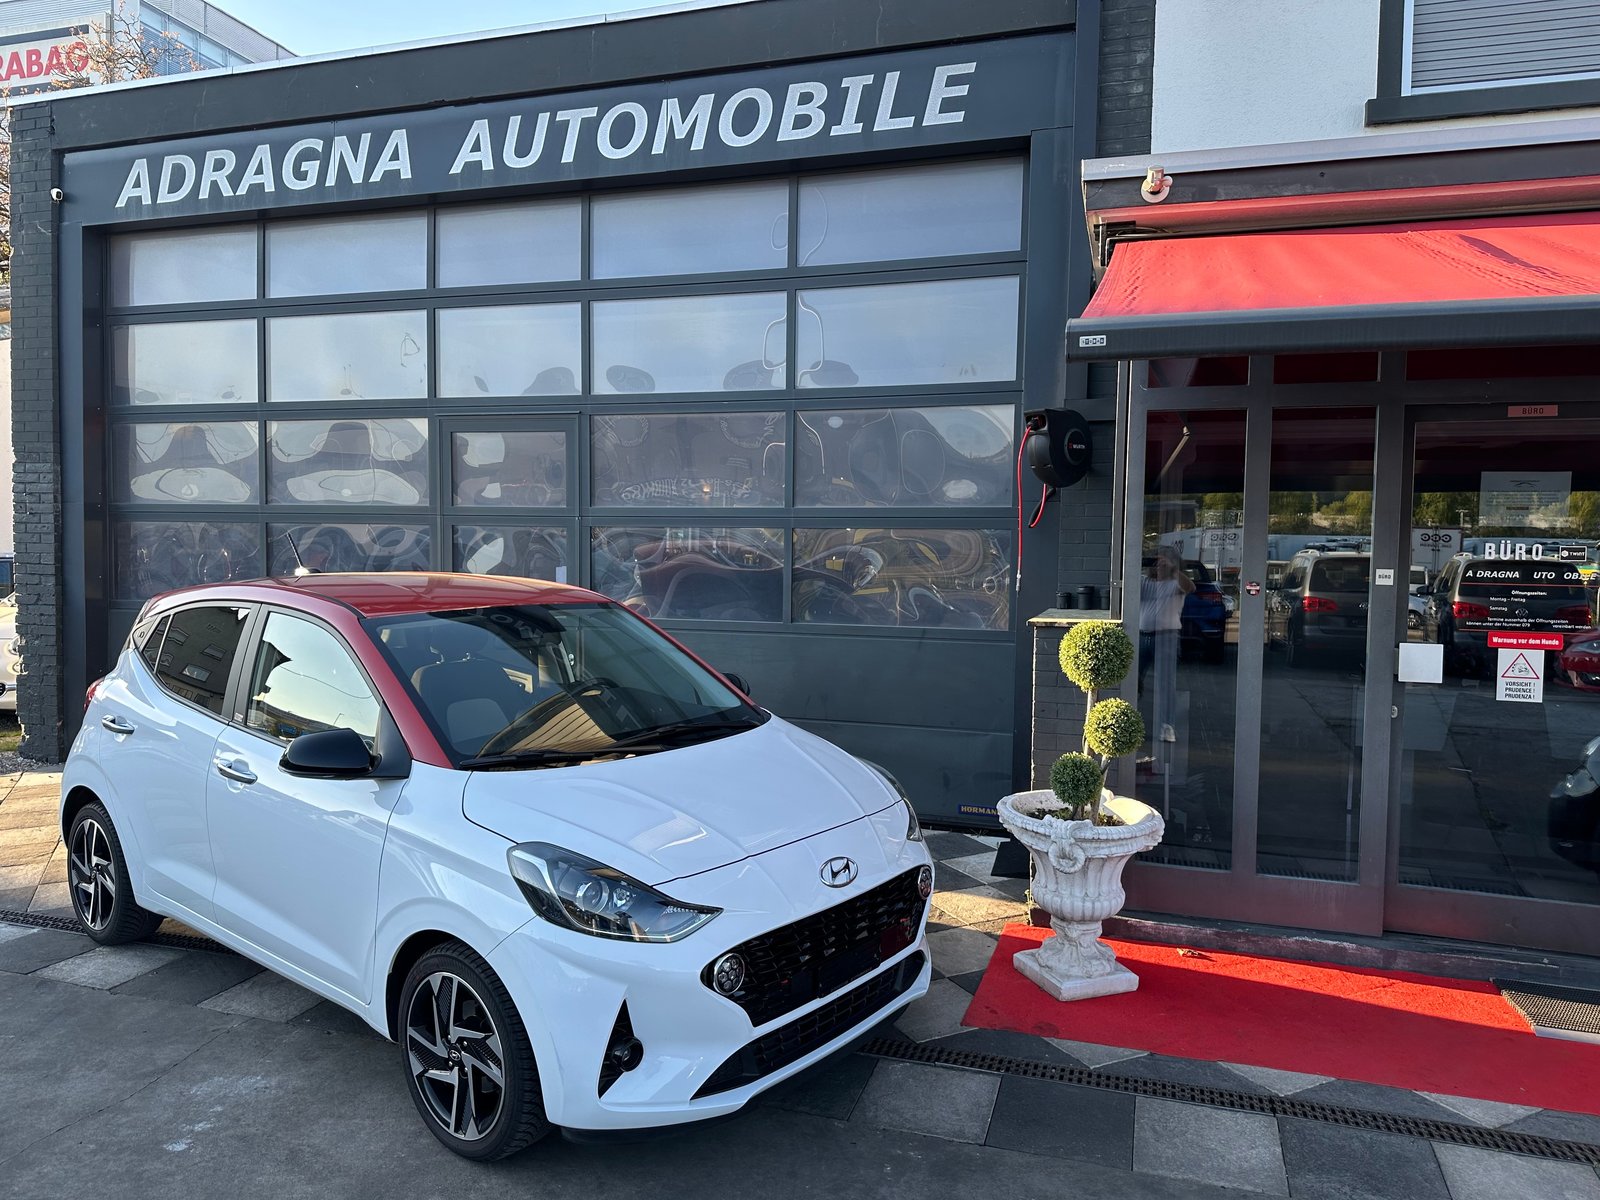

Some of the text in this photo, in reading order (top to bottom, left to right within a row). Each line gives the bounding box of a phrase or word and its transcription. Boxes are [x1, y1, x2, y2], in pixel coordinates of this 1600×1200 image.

[0, 41, 89, 81] ABAG
[115, 61, 978, 209] ADRAGNA AUTOMOBILE
[1522, 407, 1544, 415] BÜRO
[1484, 540, 1543, 560] BÜRO
[1492, 636, 1517, 644] Warnung
